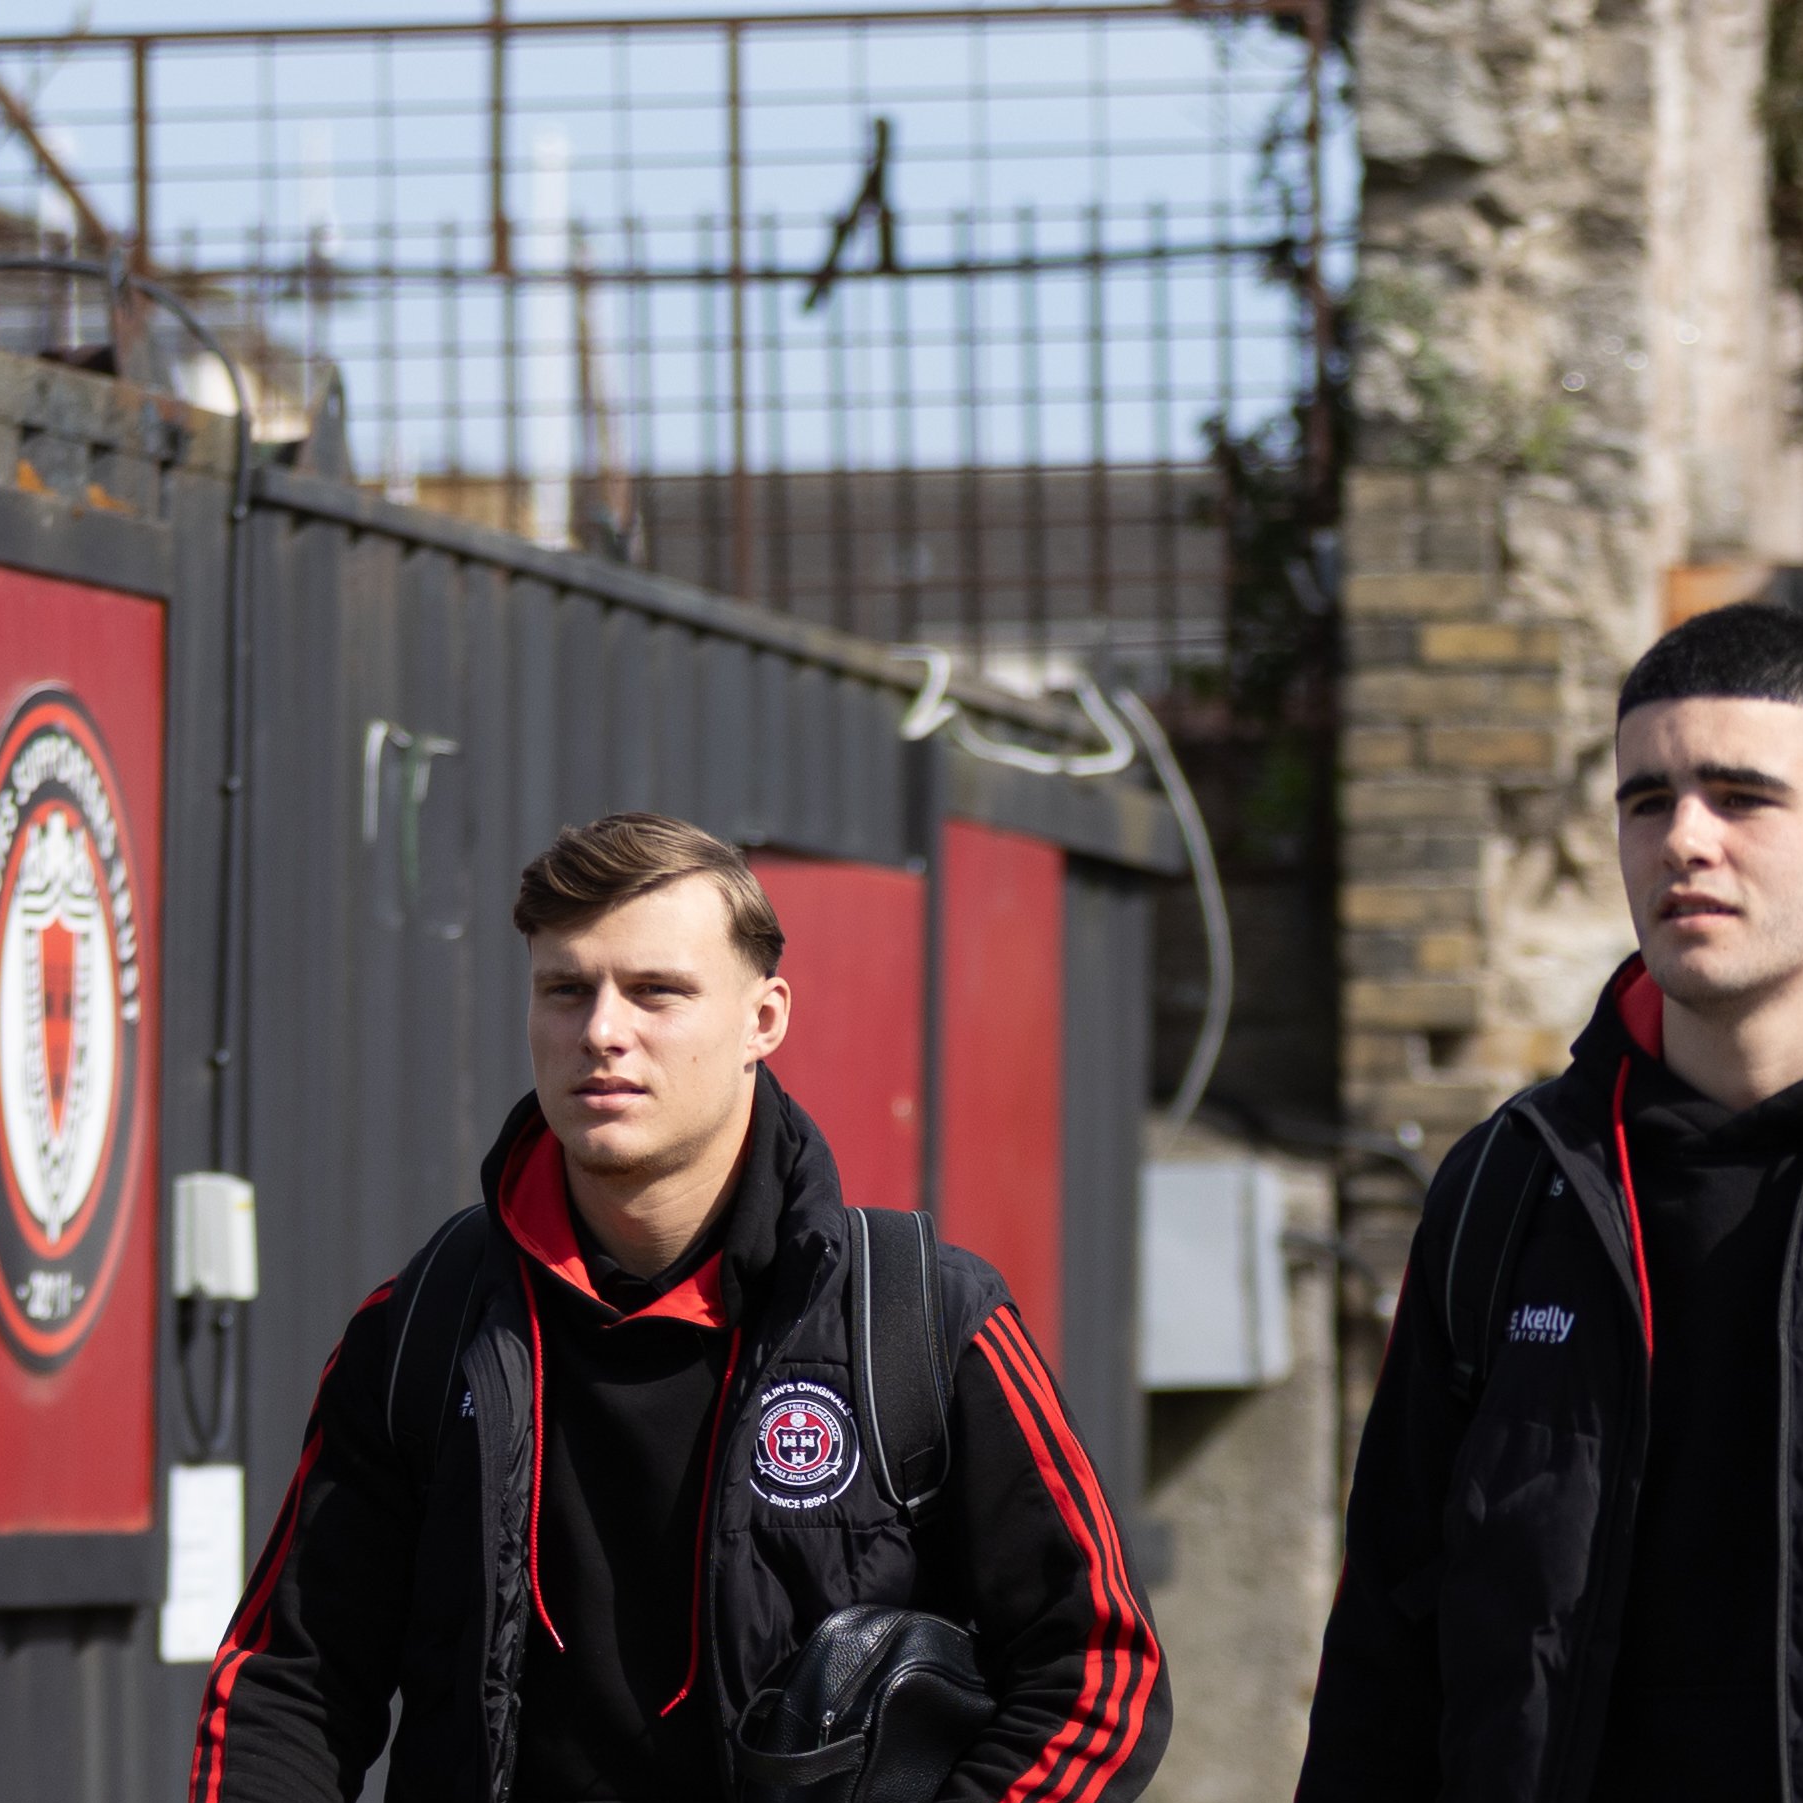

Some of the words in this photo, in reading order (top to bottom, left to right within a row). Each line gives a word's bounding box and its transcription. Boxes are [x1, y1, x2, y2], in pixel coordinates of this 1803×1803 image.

[1521, 1303, 1575, 1342] kelly
[761, 1383, 795, 1408] BLIN'S
[797, 1382, 853, 1416] ORIGINALS
[807, 1464, 830, 1480] CLIATH
[768, 1493, 801, 1509] SINCE
[802, 1493, 828, 1509] 1890
